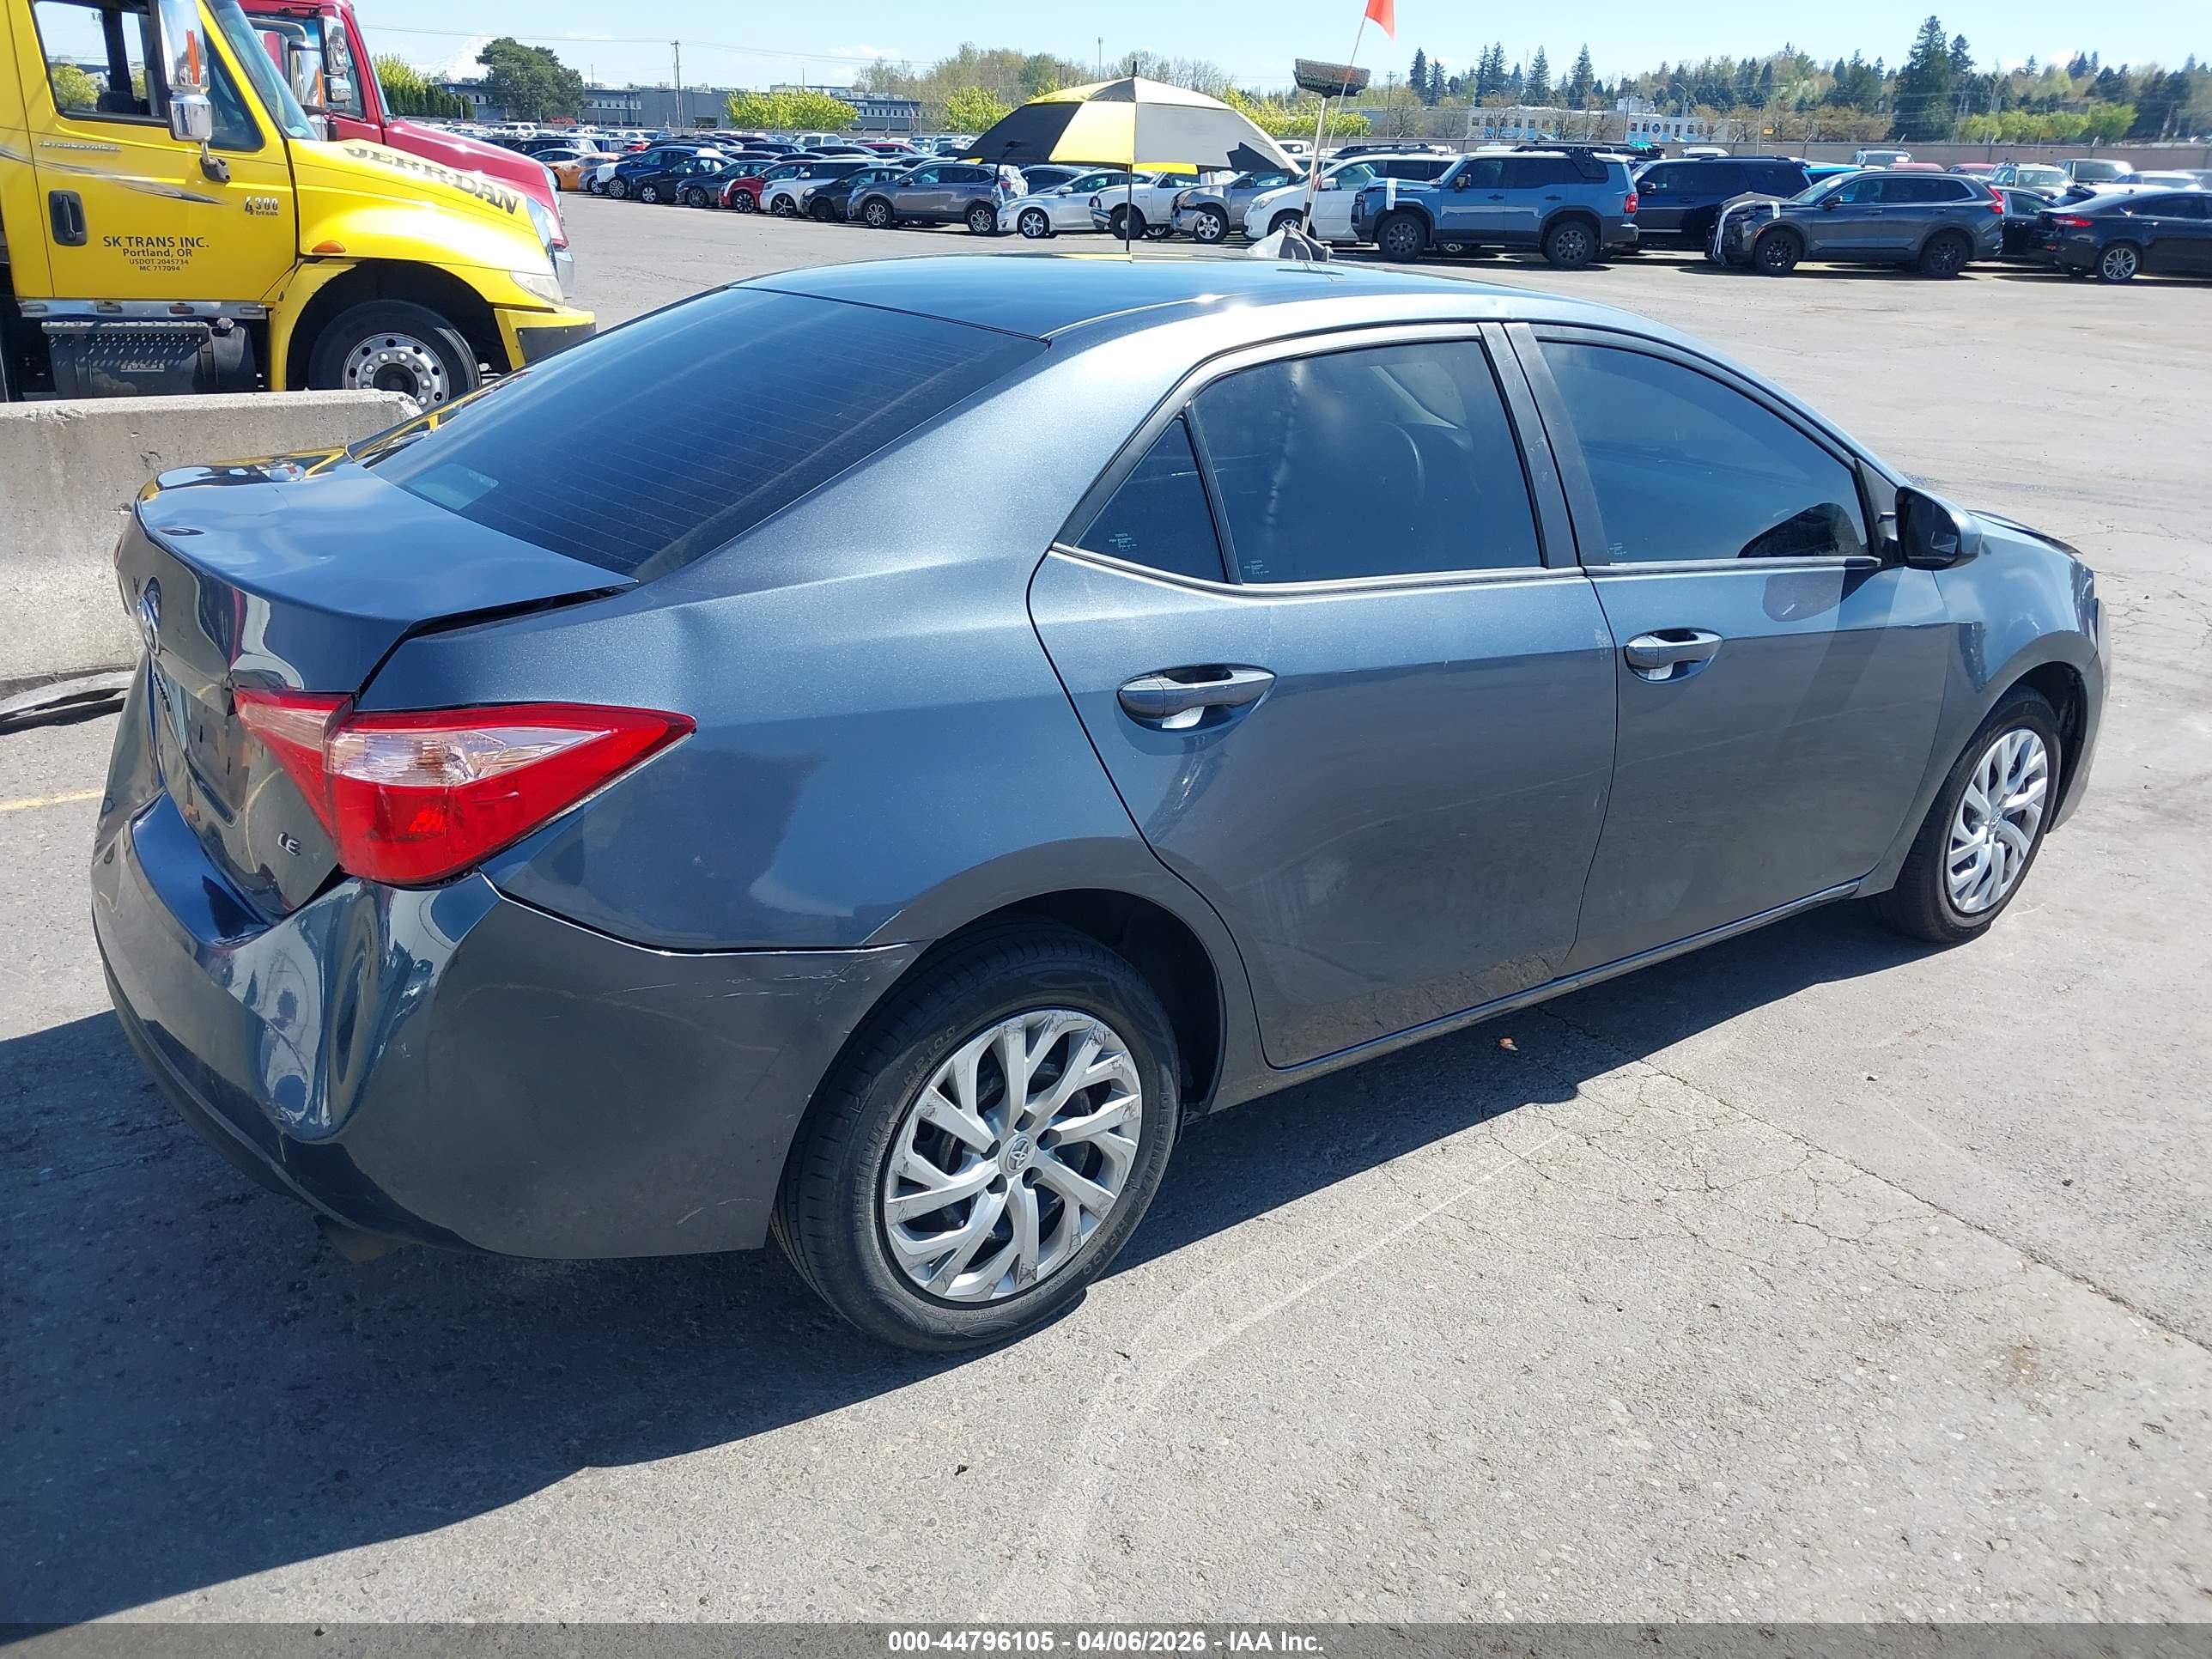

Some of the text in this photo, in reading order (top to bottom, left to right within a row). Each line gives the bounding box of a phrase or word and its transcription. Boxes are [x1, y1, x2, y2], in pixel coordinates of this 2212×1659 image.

[344, 147, 520, 216] JERR-DAN
[245, 196, 278, 215] 4300
[102, 235, 210, 248] SK TRANS INC.
[123, 247, 192, 258] Portland, OR
[277, 832, 301, 856] LE
